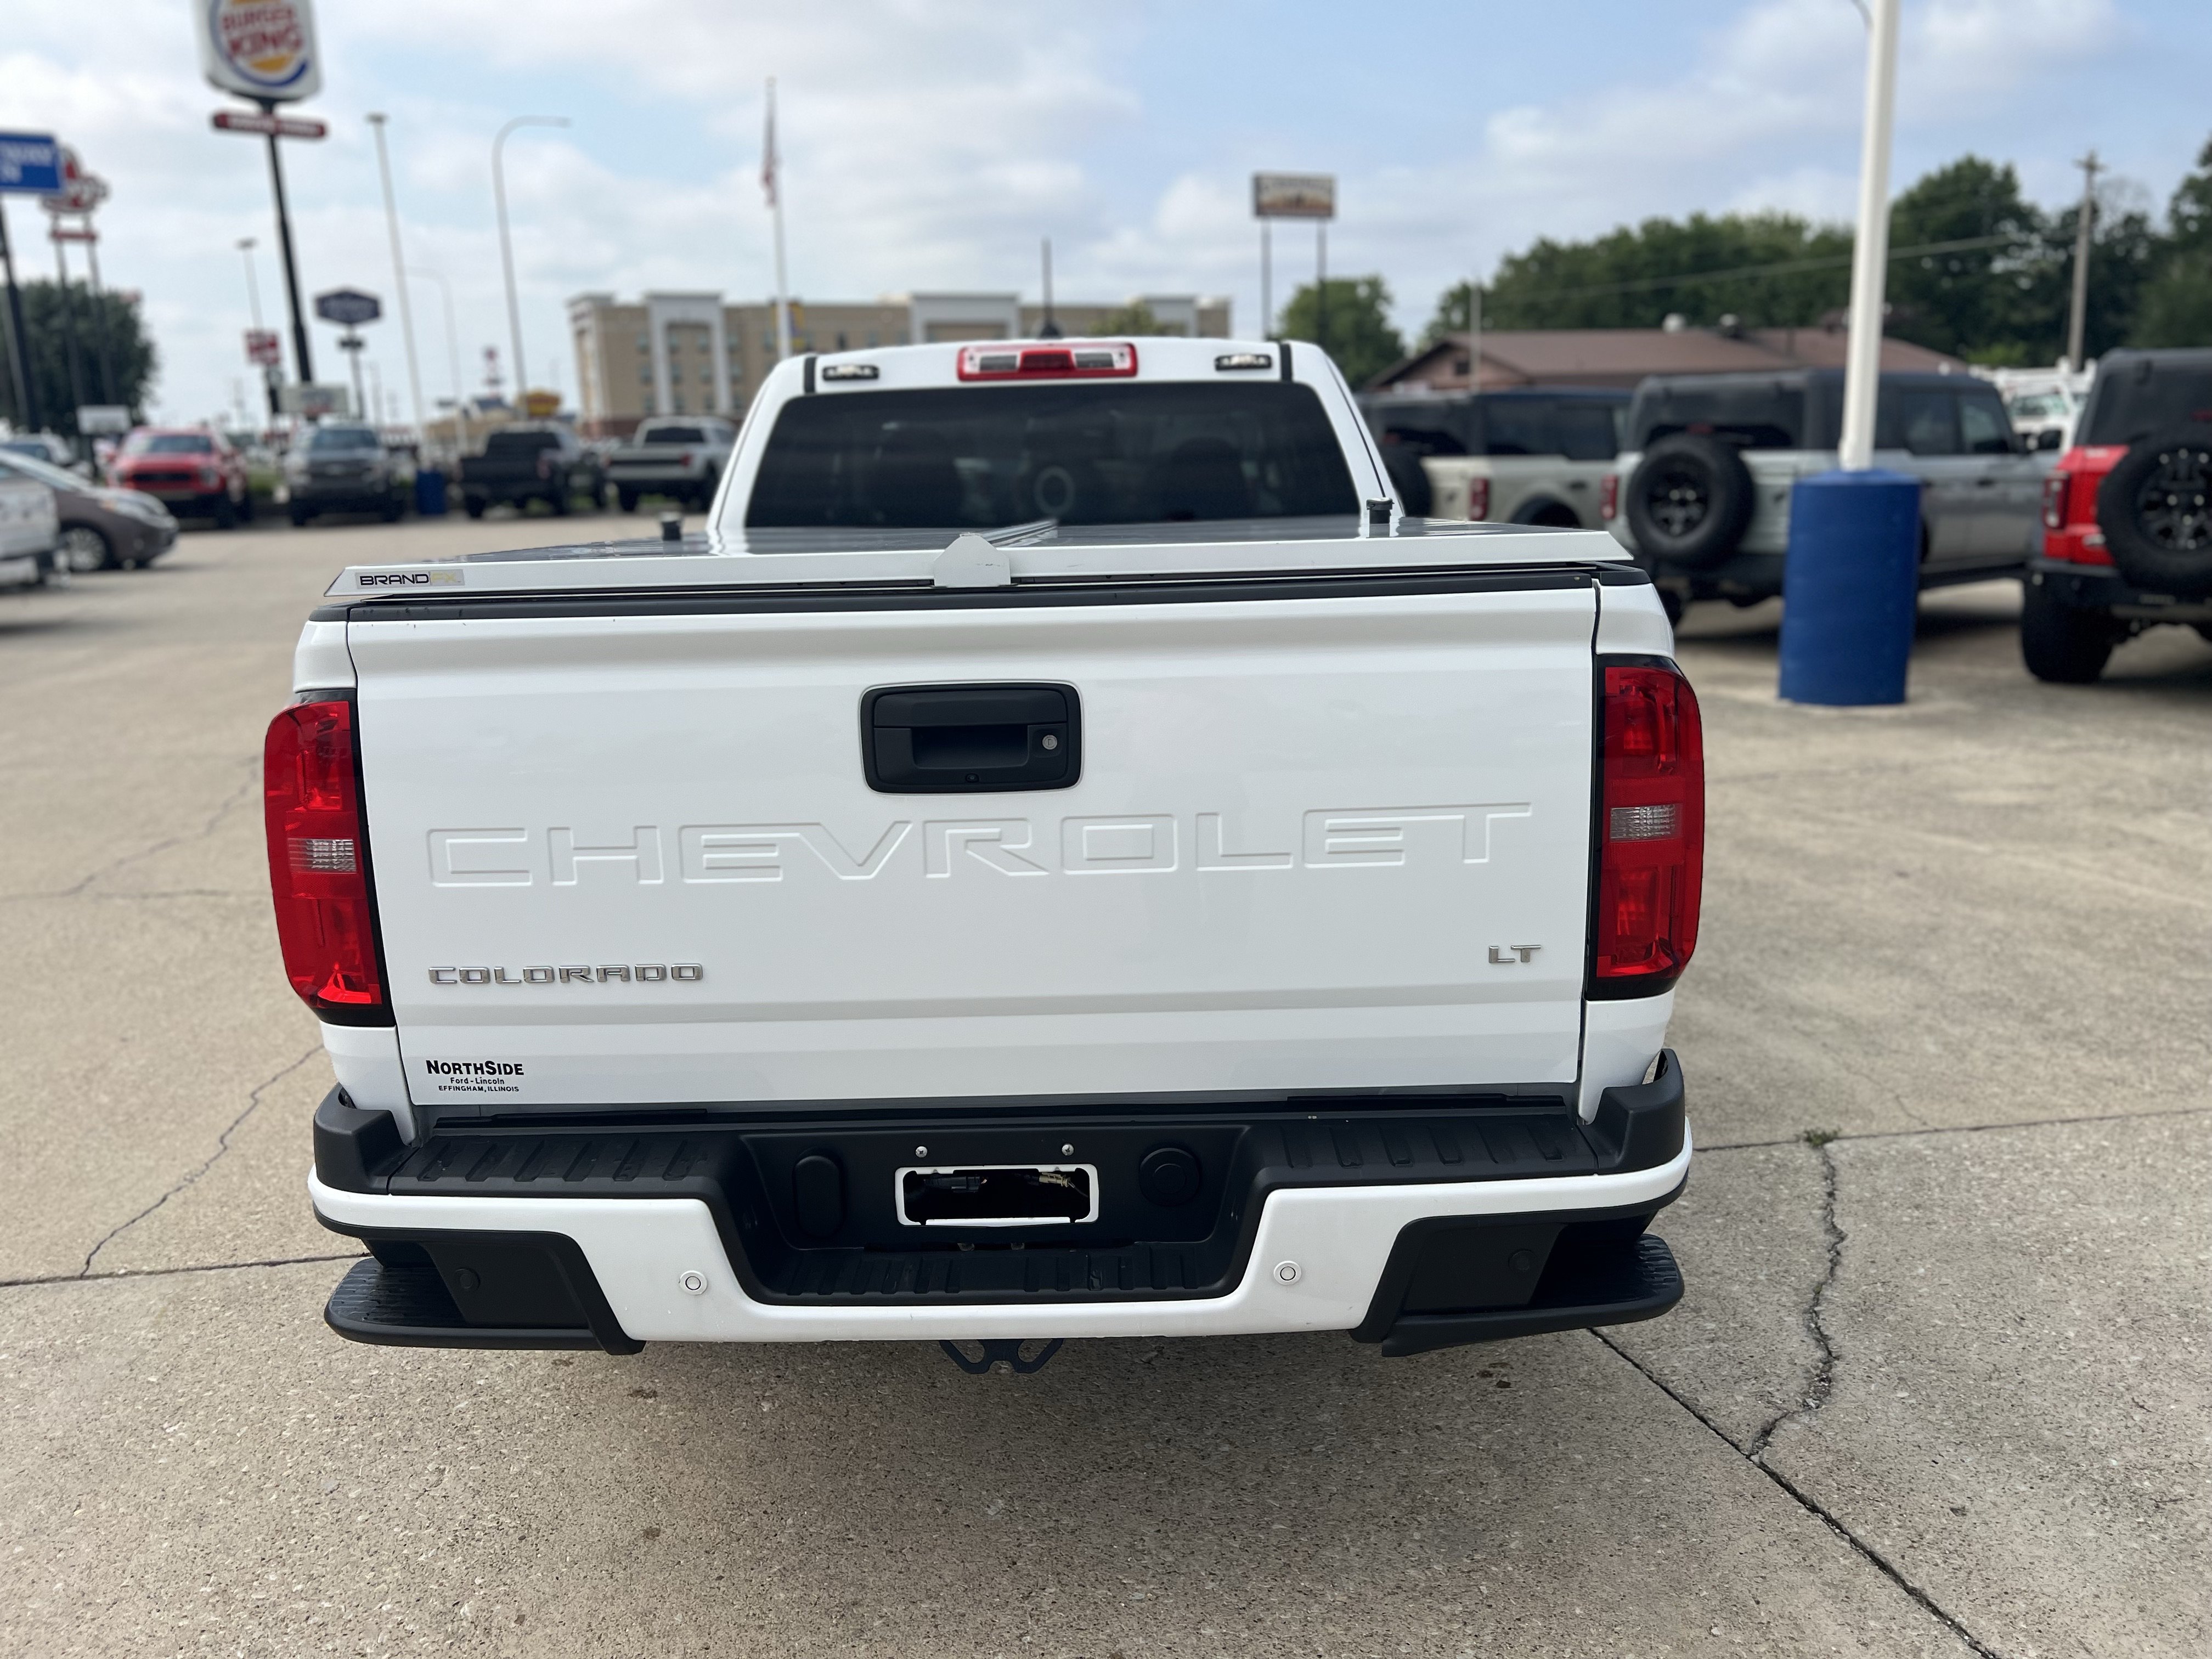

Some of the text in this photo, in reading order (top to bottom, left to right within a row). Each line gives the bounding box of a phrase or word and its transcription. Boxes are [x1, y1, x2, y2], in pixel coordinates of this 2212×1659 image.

[222, 8, 295, 30] BURGER
[228, 25, 304, 58] KING
[359, 573, 430, 586] BRAND
[427, 802, 1532, 887] CHEVROLET
[1488, 944, 1542, 963] LT
[427, 962, 704, 985] COLORADO
